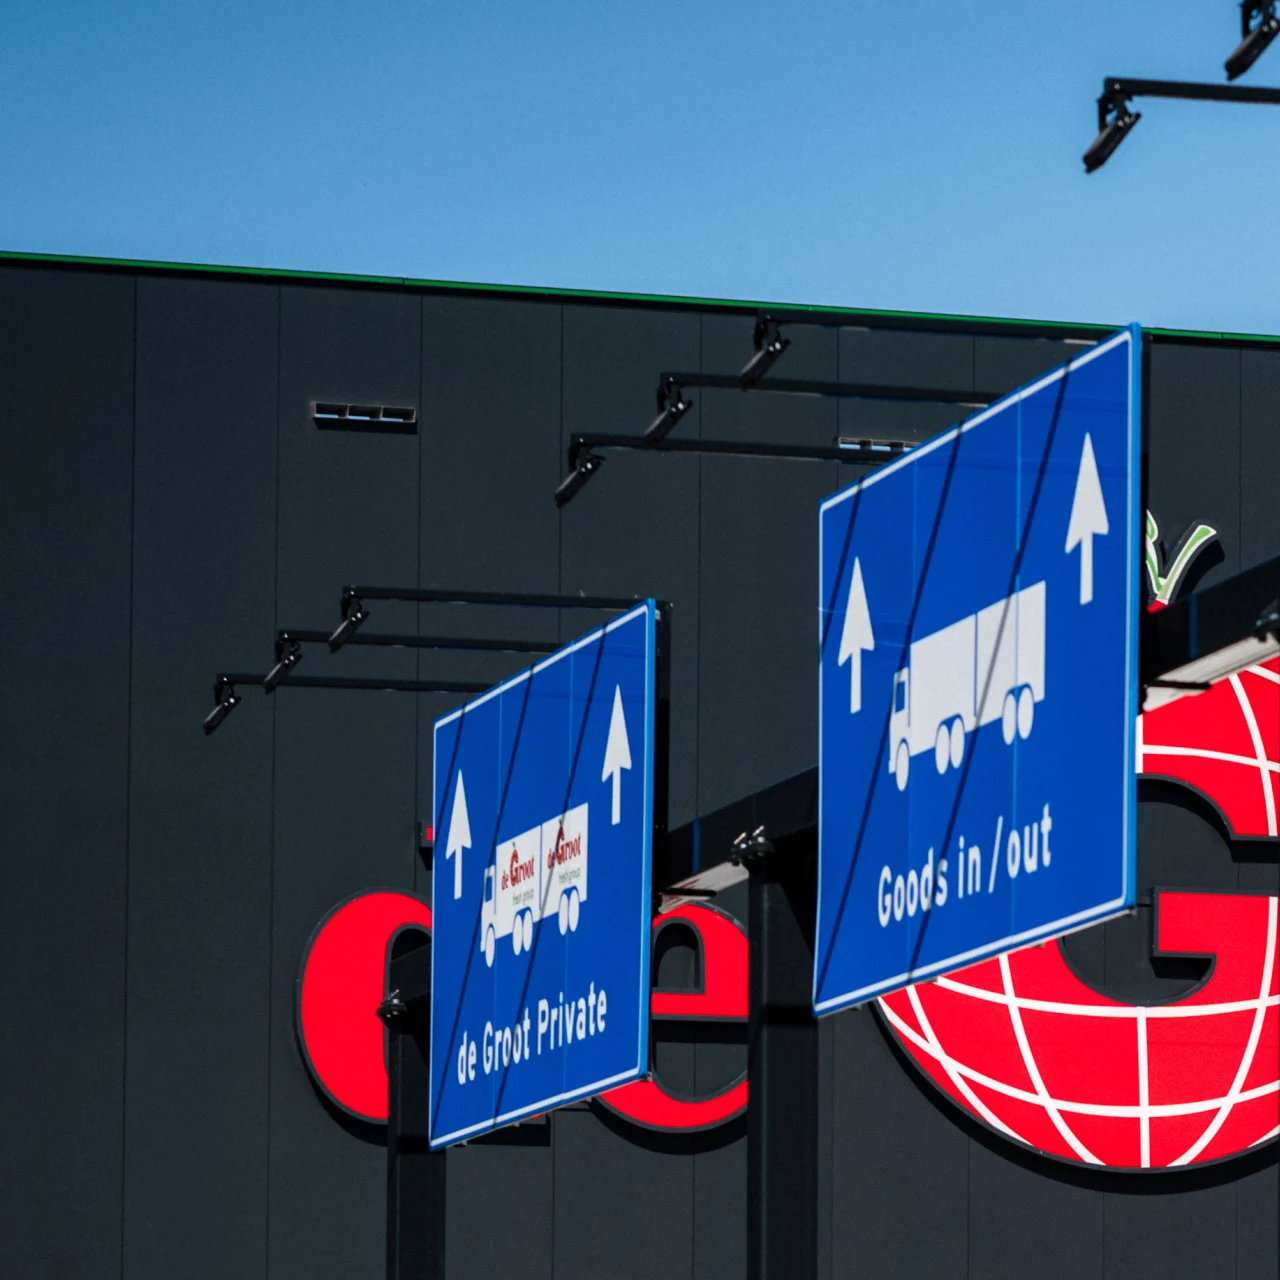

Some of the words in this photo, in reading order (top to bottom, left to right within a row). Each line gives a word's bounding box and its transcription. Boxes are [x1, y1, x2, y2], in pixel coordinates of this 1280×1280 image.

[878, 846, 948, 928] Goods
[958, 835, 981, 899] in
[1007, 802, 1052, 878] out
[457, 1030, 477, 1085] de
[483, 1007, 531, 1075] Groot
[537, 981, 607, 1055] Private
